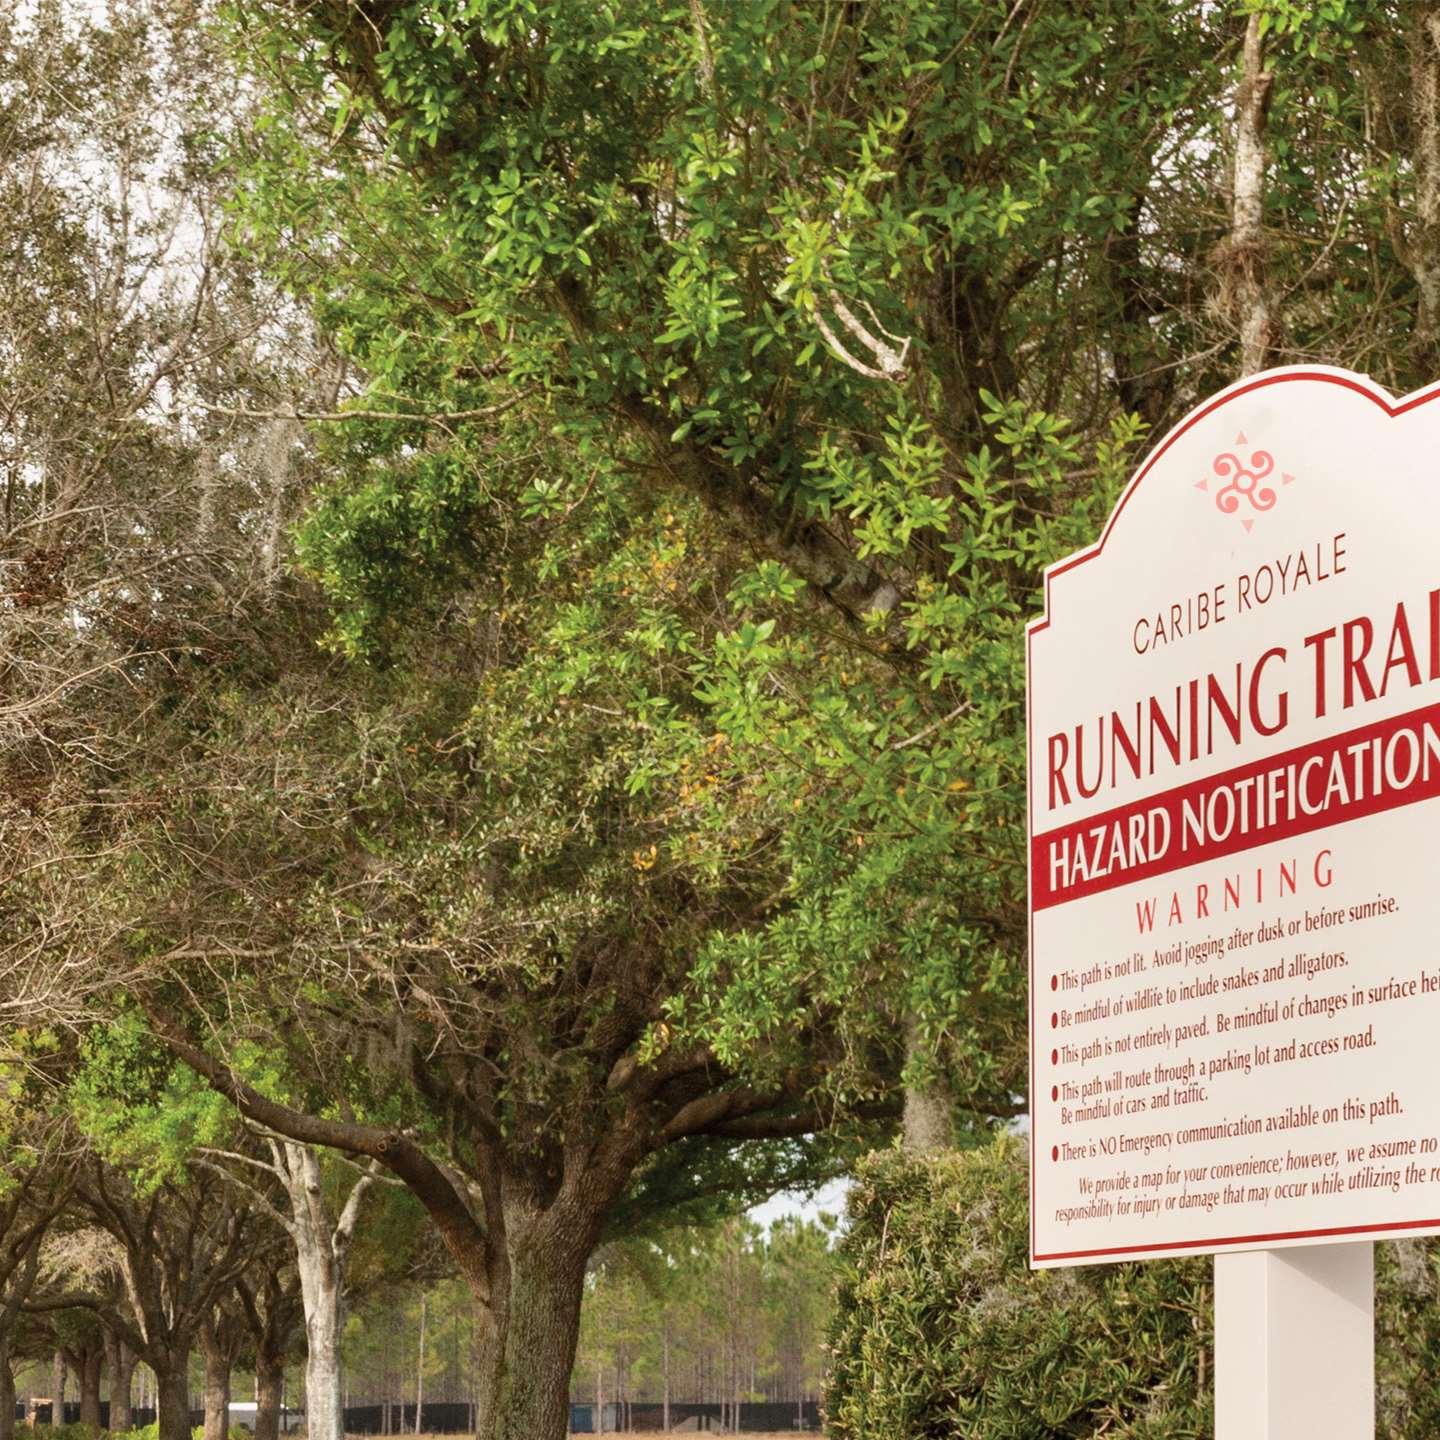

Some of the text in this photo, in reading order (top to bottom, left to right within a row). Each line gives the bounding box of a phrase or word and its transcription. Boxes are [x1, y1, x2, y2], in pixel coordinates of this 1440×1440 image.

[1132, 533, 1348, 655] CARIBE ROYALE
[1048, 588, 1440, 810] RUNNING TRAI
[1049, 807, 1171, 892] HAZARD
[1136, 849, 1333, 934] WARNING
[1061, 894, 1399, 992] This path is not lit. Avoid jogging after dusk or before sunrise.
[1061, 951, 1348, 1028] Be mindful of wildlife to include snakes and alligators.
[1061, 1046, 1079, 1065] This
[1081, 1038, 1101, 1067] path
[1105, 1036, 1112, 1054] is
[1115, 1036, 1130, 1053] not
[1134, 1024, 1172, 1050] entirely
[1175, 1016, 1210, 1047] paved.
[1216, 1013, 1230, 1033] Be
[1234, 1001, 1278, 1029] mindful
[1282, 997, 1295, 1020] of
[1298, 995, 1348, 1018] changes
[1352, 985, 1364, 1006] in
[1368, 977, 1416, 1004] surface
[1061, 1082, 1208, 1125] Be mindful of cars and traffic.
[1062, 1024, 1376, 1105] This path will route through a parking lot and access road.
[1062, 1092, 1403, 1161] There is NO Emergency communication available on this path.
[1080, 1137, 1437, 1199] We provide a map for your convenience; however, we assume no
[1055, 1199, 1114, 1226] responsibility
[1117, 1196, 1130, 1215] for
[1133, 1194, 1161, 1218] injury
[1166, 1195, 1176, 1209] or
[1179, 1190, 1219, 1212] damage
[1223, 1184, 1244, 1204] that
[1248, 1187, 1271, 1206] may
[1275, 1181, 1308, 1199] occur
[1312, 1172, 1344, 1195] while
[1349, 1166, 1400, 1192] utilizing
[1406, 1162, 1426, 1184] the
